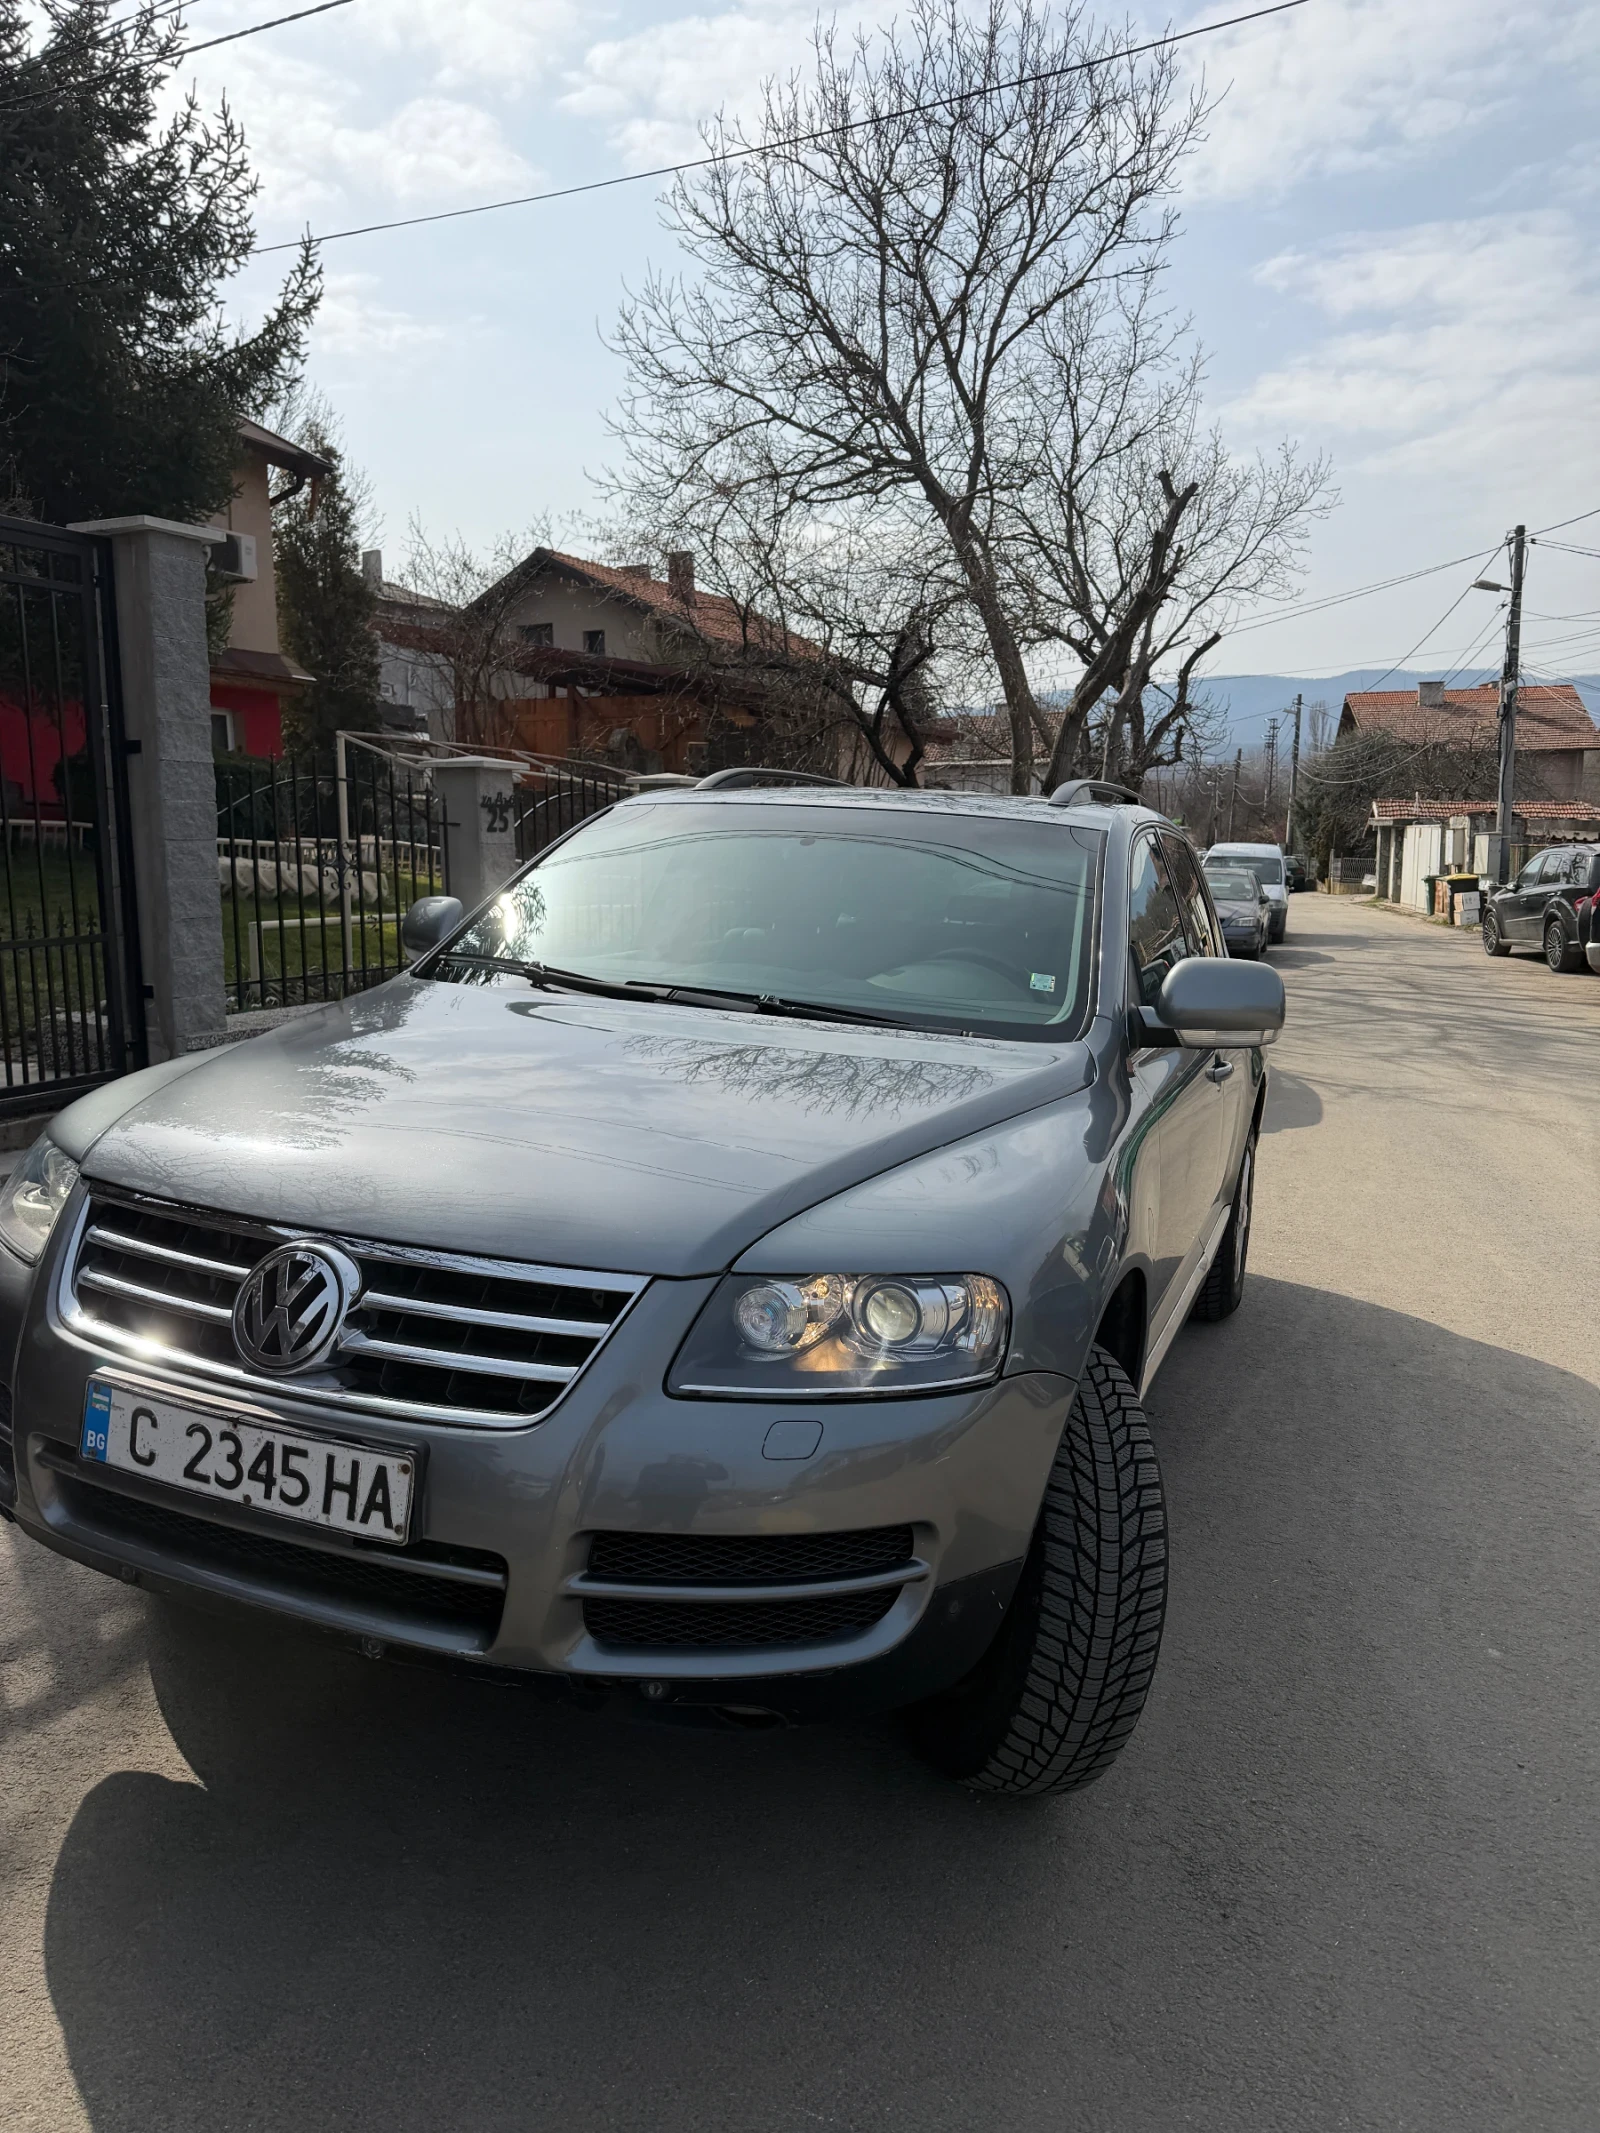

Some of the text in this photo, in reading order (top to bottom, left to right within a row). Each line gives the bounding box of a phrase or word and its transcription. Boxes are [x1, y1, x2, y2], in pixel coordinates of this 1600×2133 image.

[487, 806, 509, 832] 25
[86, 1429, 106, 1451] BG
[129, 1406, 394, 1530] C 2345 HA
